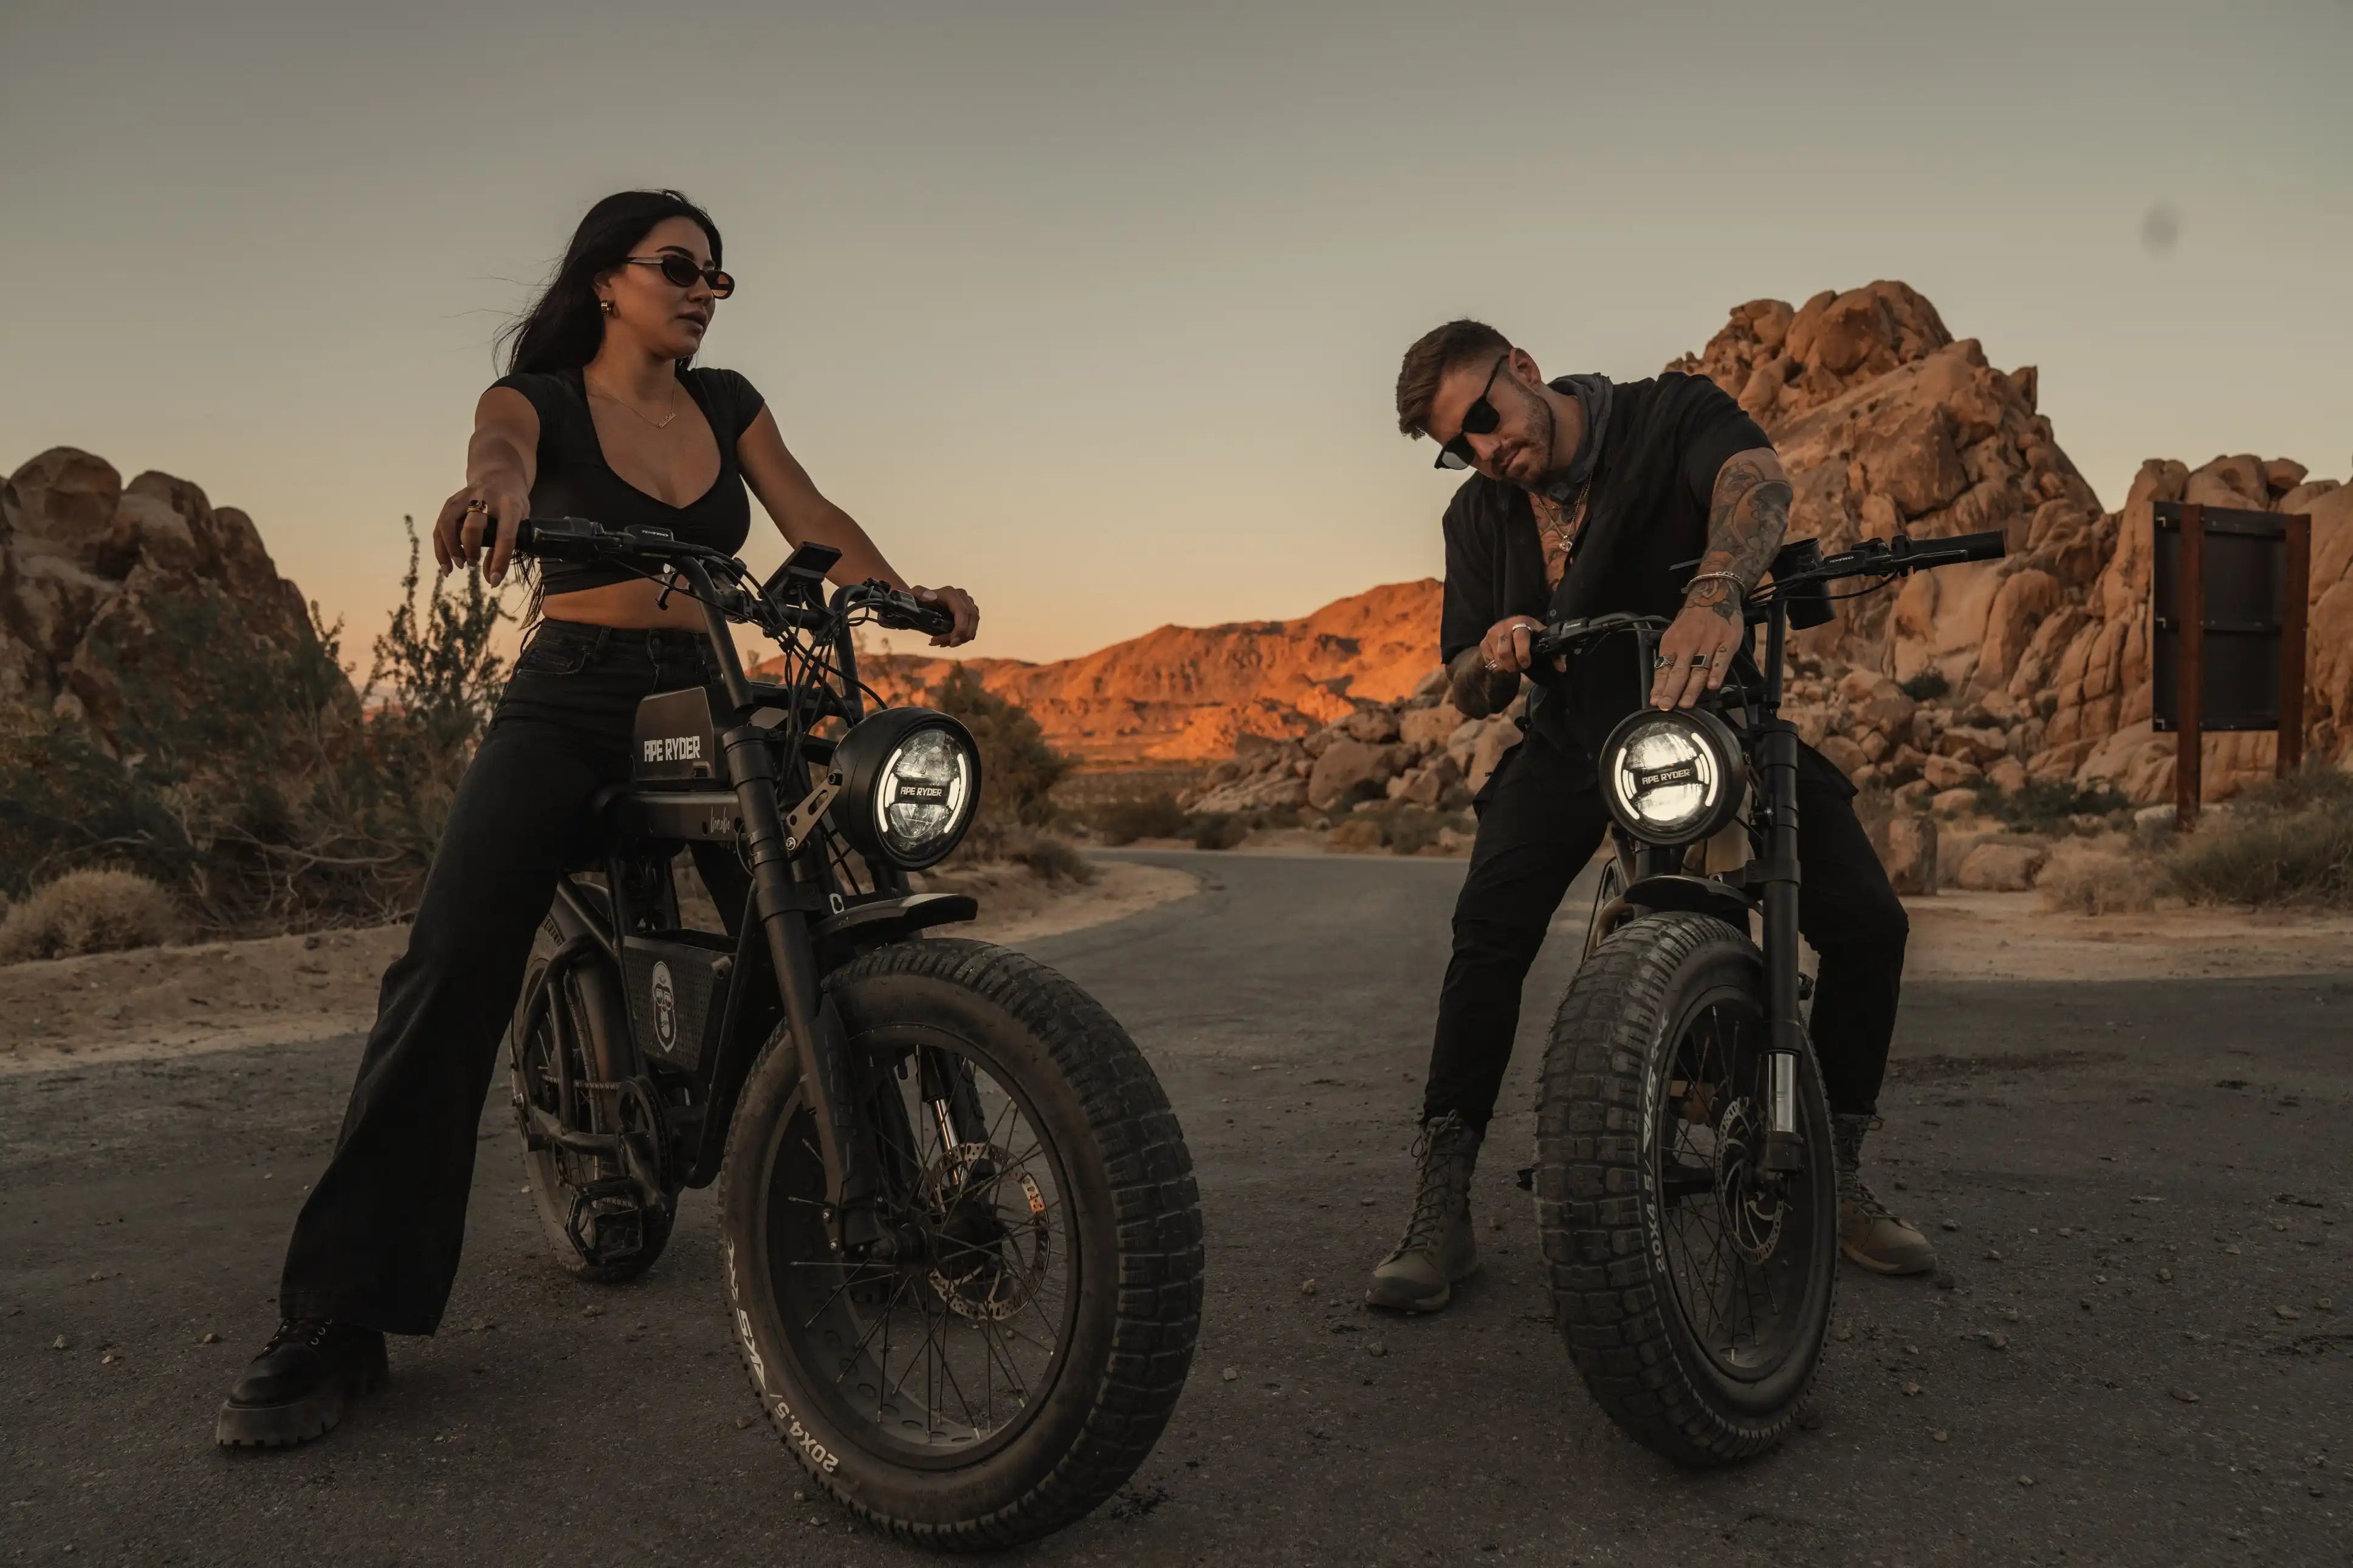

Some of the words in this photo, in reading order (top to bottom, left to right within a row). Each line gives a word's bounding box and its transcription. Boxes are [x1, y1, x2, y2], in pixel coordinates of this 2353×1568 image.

[644, 739, 663, 762] APE
[665, 736, 701, 761] RYDER
[1641, 775, 1660, 785] APE
[1660, 769, 1691, 781] RYDER
[900, 786, 916, 795] APE
[916, 787, 943, 797] RYDER
